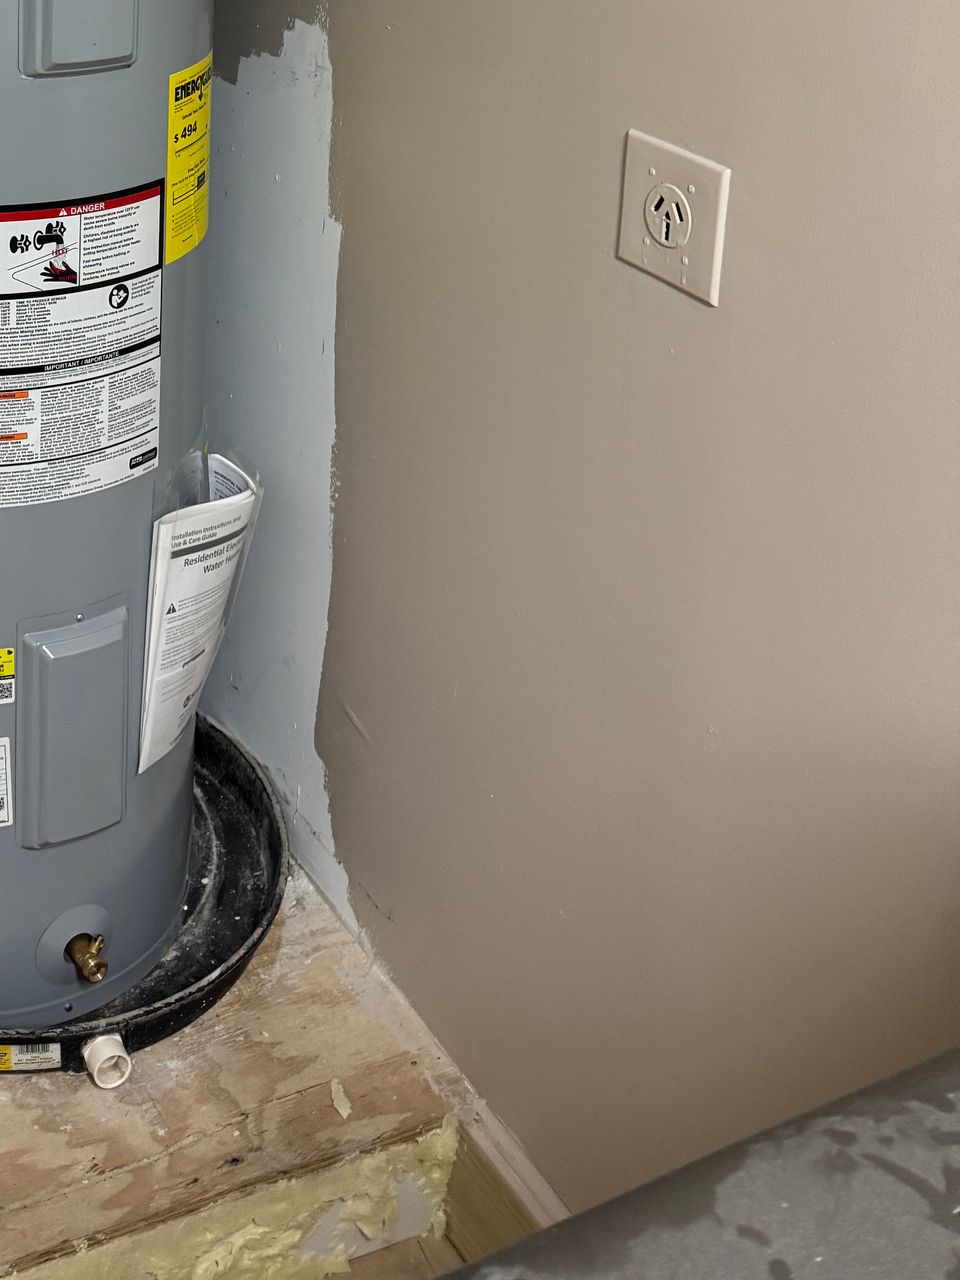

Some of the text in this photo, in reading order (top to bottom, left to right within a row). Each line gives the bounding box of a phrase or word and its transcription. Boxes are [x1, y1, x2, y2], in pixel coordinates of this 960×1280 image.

[181, 121, 197, 139] 494
[71, 203, 105, 215] DANGER
[44, 361, 80, 371] IMPORTANT
[172, 529, 202, 541] Installation
[203, 520, 232, 532] Instructions
[202, 532, 218, 541] Guide
[184, 546, 225, 567] Residential
[203, 560, 224, 574] Water
